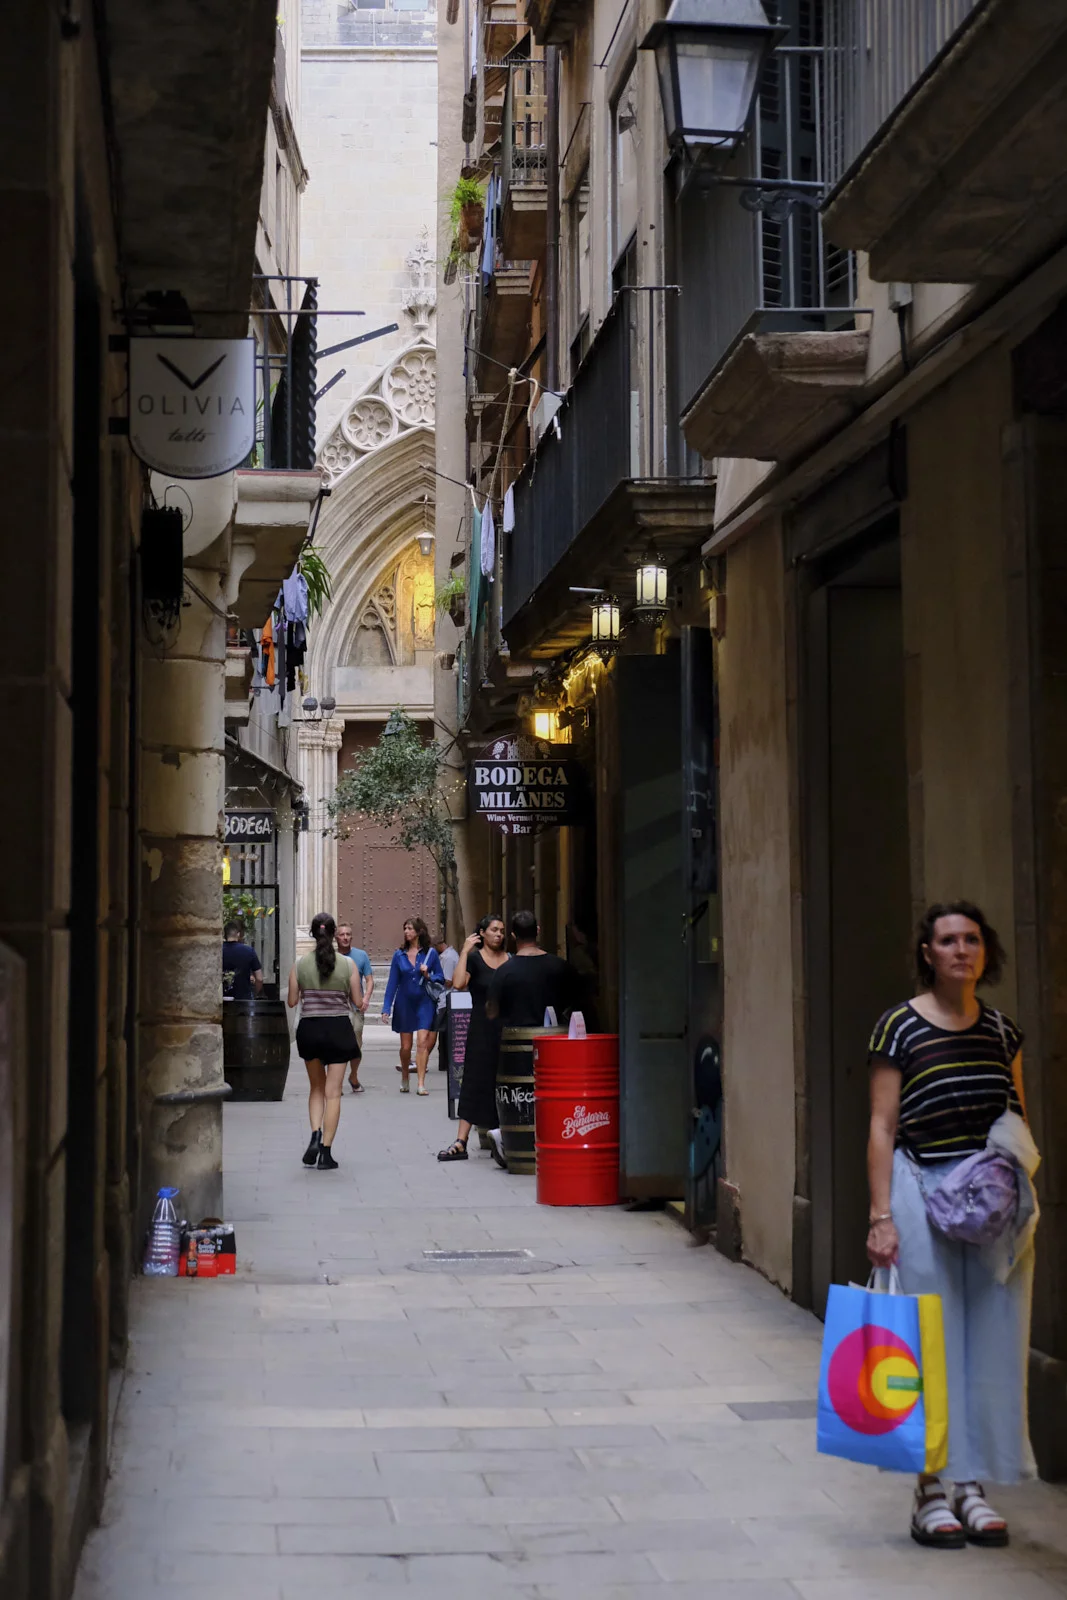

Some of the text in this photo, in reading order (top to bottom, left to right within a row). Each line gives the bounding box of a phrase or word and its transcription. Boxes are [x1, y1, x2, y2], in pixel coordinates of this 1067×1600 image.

[138, 394, 245, 416] OLIVIA
[474, 766, 569, 786] BODEGA
[479, 791, 566, 808] MILANES
[486, 813, 506, 822] Wine
[535, 813, 558, 823] Tapas
[512, 823, 532, 834] Bar
[573, 1104, 586, 1119] El
[561, 1111, 610, 1140] Bandarra
